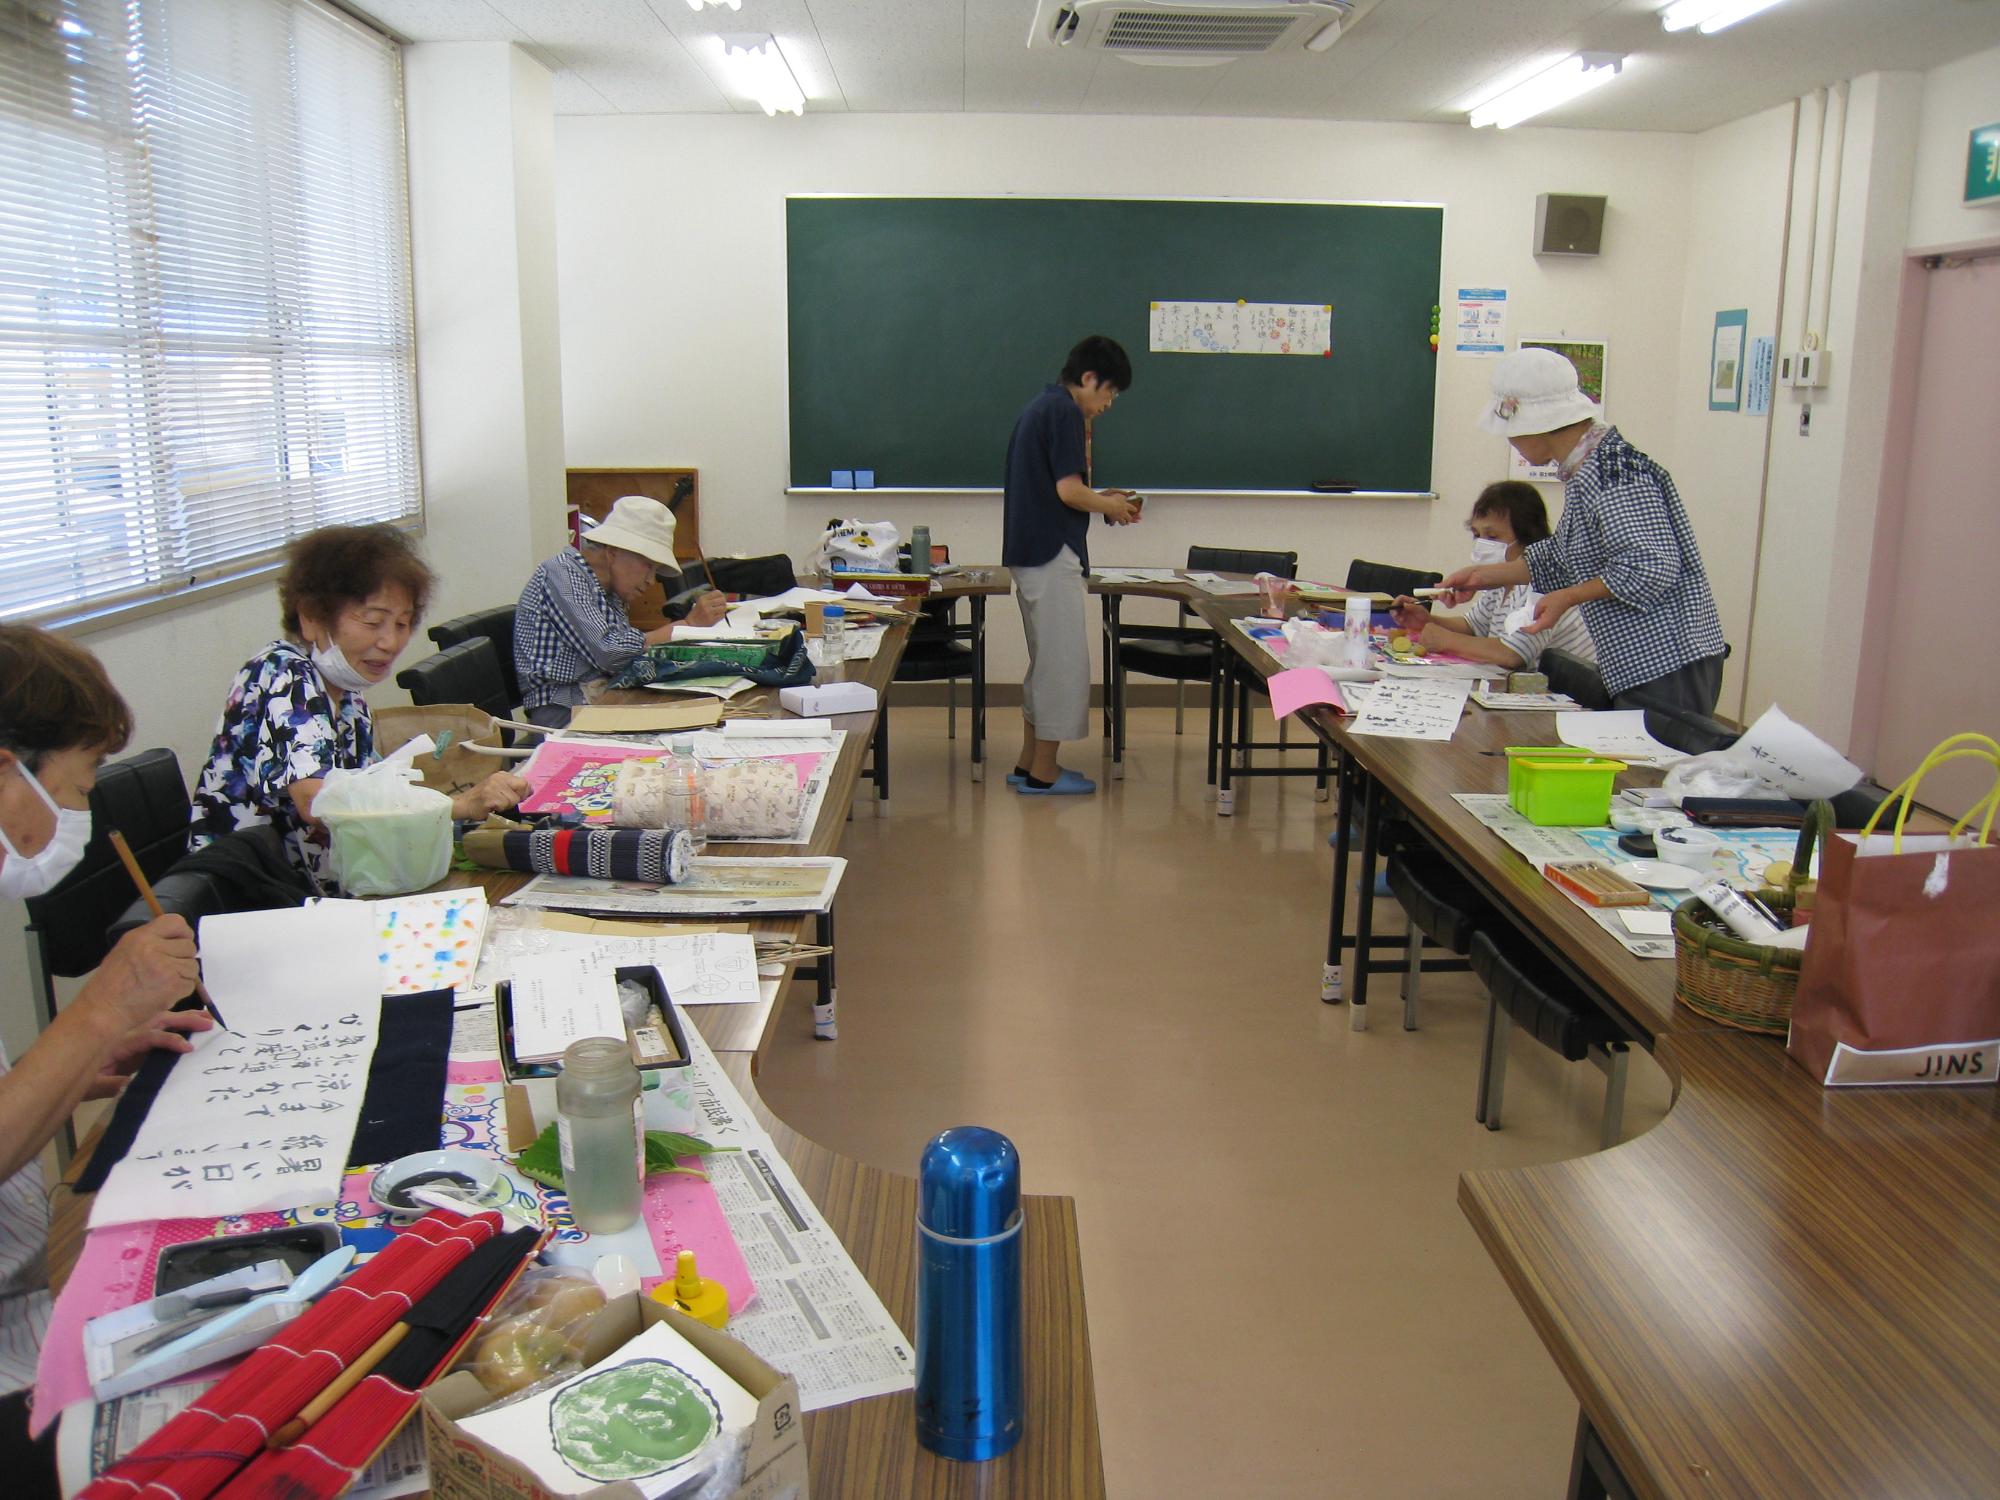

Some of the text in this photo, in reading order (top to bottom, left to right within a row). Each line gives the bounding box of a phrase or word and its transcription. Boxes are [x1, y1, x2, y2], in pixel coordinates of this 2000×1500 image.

[203, 1053, 359, 1075] 北海道も
[205, 1073, 351, 1103] 涼しかった
[244, 1099, 345, 1117] 今まで
[162, 1153, 322, 1190] 暑い日が
